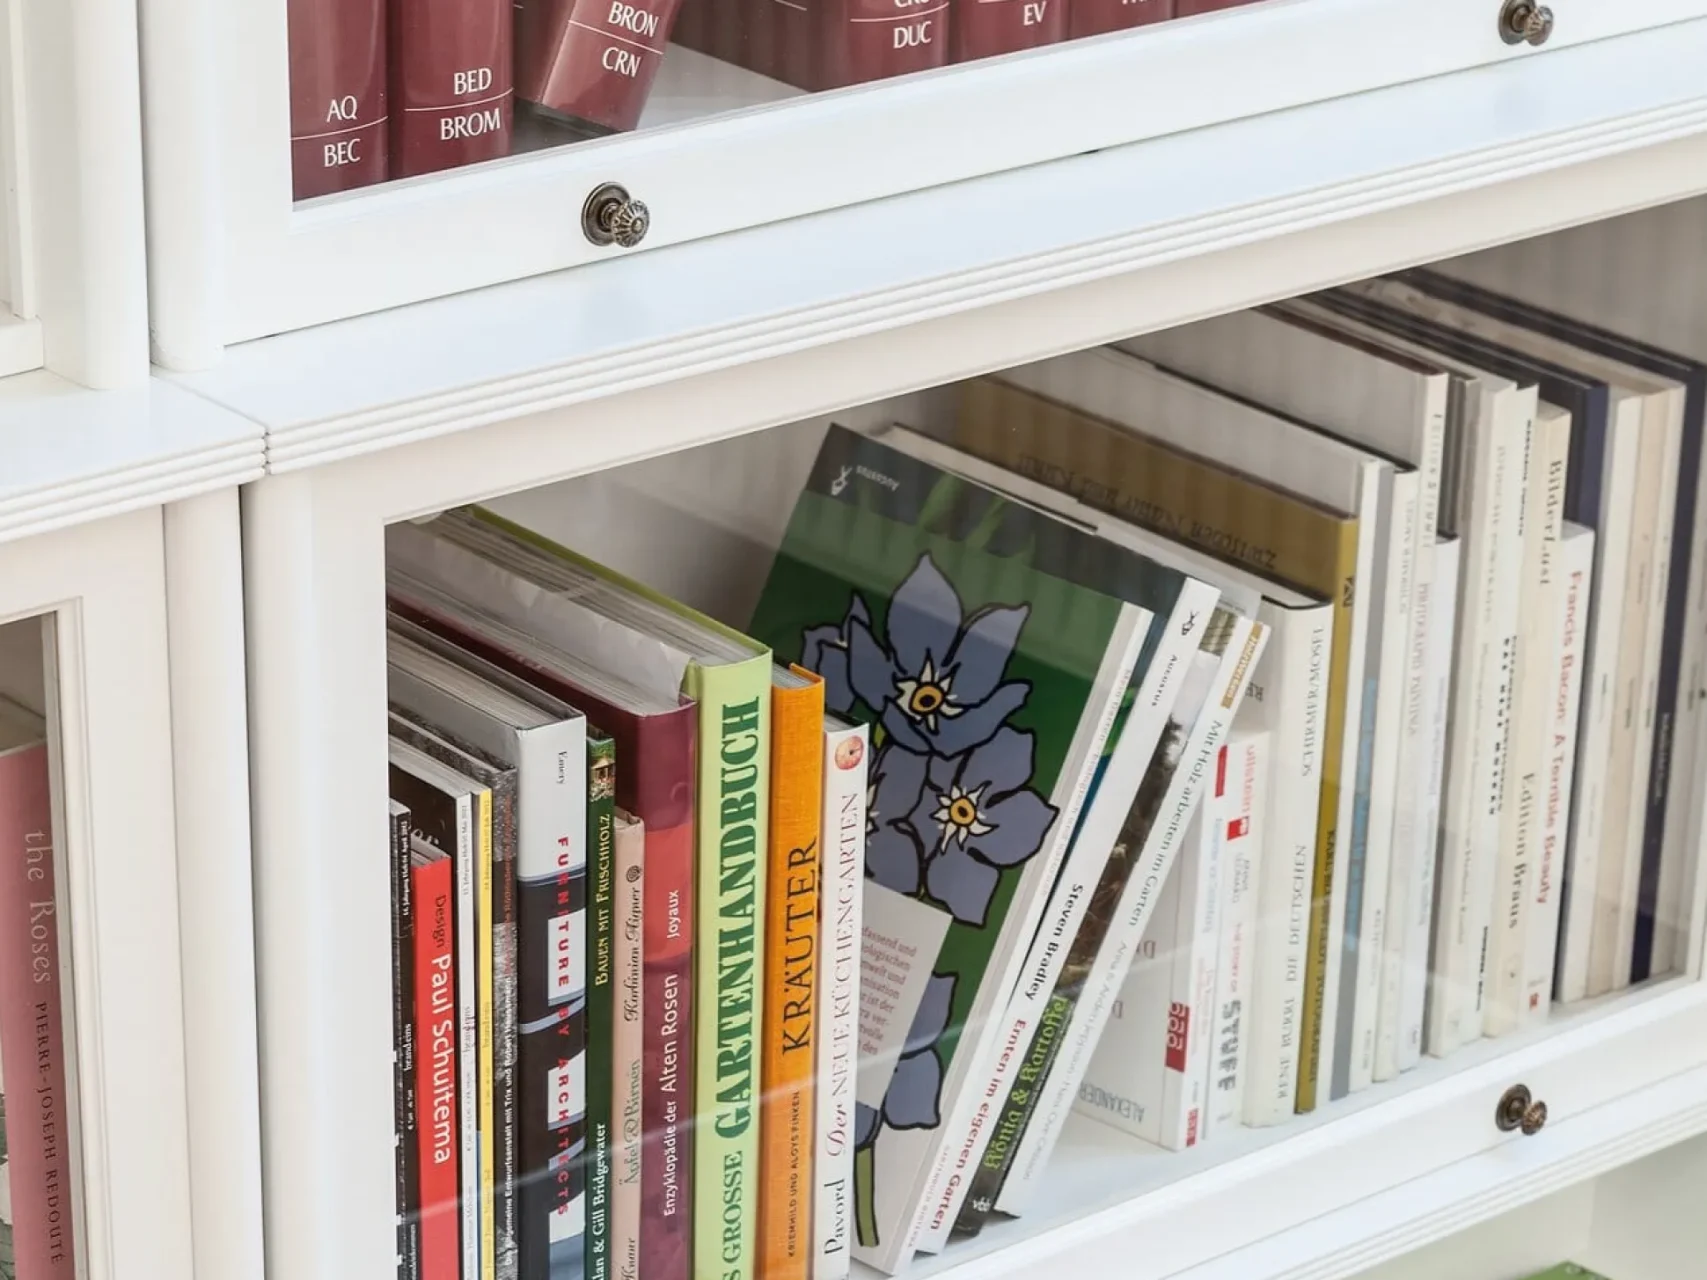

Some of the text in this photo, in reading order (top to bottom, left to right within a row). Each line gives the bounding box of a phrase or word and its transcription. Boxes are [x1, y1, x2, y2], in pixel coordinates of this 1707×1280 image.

[608, 1, 659, 37] BRON
[892, 21, 932, 49] DUC
[1023, 2, 1046, 26] EV
[453, 68, 492, 95] BED
[602, 46, 641, 78] CRN
[326, 95, 358, 122] AQ
[440, 108, 501, 140] BROM
[323, 138, 361, 167] BEC
[1562, 569, 1583, 648] Francis
[1203, 718, 1222, 746] Mit
[1187, 748, 1210, 785] Holz
[1545, 754, 1565, 828] Terrible
[1159, 785, 1195, 852] arbeiten
[1151, 853, 1166, 874] im
[1289, 844, 1308, 945] DEUTSCHEN
[1536, 834, 1557, 904] Beauty
[25, 828, 56, 985] the Roses
[666, 889, 680, 939] Joyaux
[714, 696, 760, 1139] GARTENHANDBUCH
[1128, 873, 1158, 928] Garten
[782, 836, 818, 1056] KRÄUTER
[1025, 883, 1083, 1001] Steven Bradley
[1287, 954, 1299, 982] DIE
[431, 894, 455, 1164] Design Paul Schuitema
[557, 835, 570, 1216] FURNITURE BY ARCHITECTS
[824, 793, 859, 1256] Pavord Der NEUE KÜCHENGARTEN
[1218, 999, 1241, 1091] STUFF
[660, 973, 679, 1217] Enzyklopädie der Alten Rosen
[983, 994, 1070, 1171] König & Kartoffel
[35, 1001, 65, 1265] PIERRE-JOSEPH REDOUTÉ
[929, 1017, 1027, 1232] Ernten im eigenen Garten
[592, 1123, 606, 1207] Bridgewater
[789, 1172, 798, 1197] UND
[592, 1211, 605, 1237] Gill
[722, 1150, 744, 1264] GROSSE
[593, 1239, 605, 1254] &
